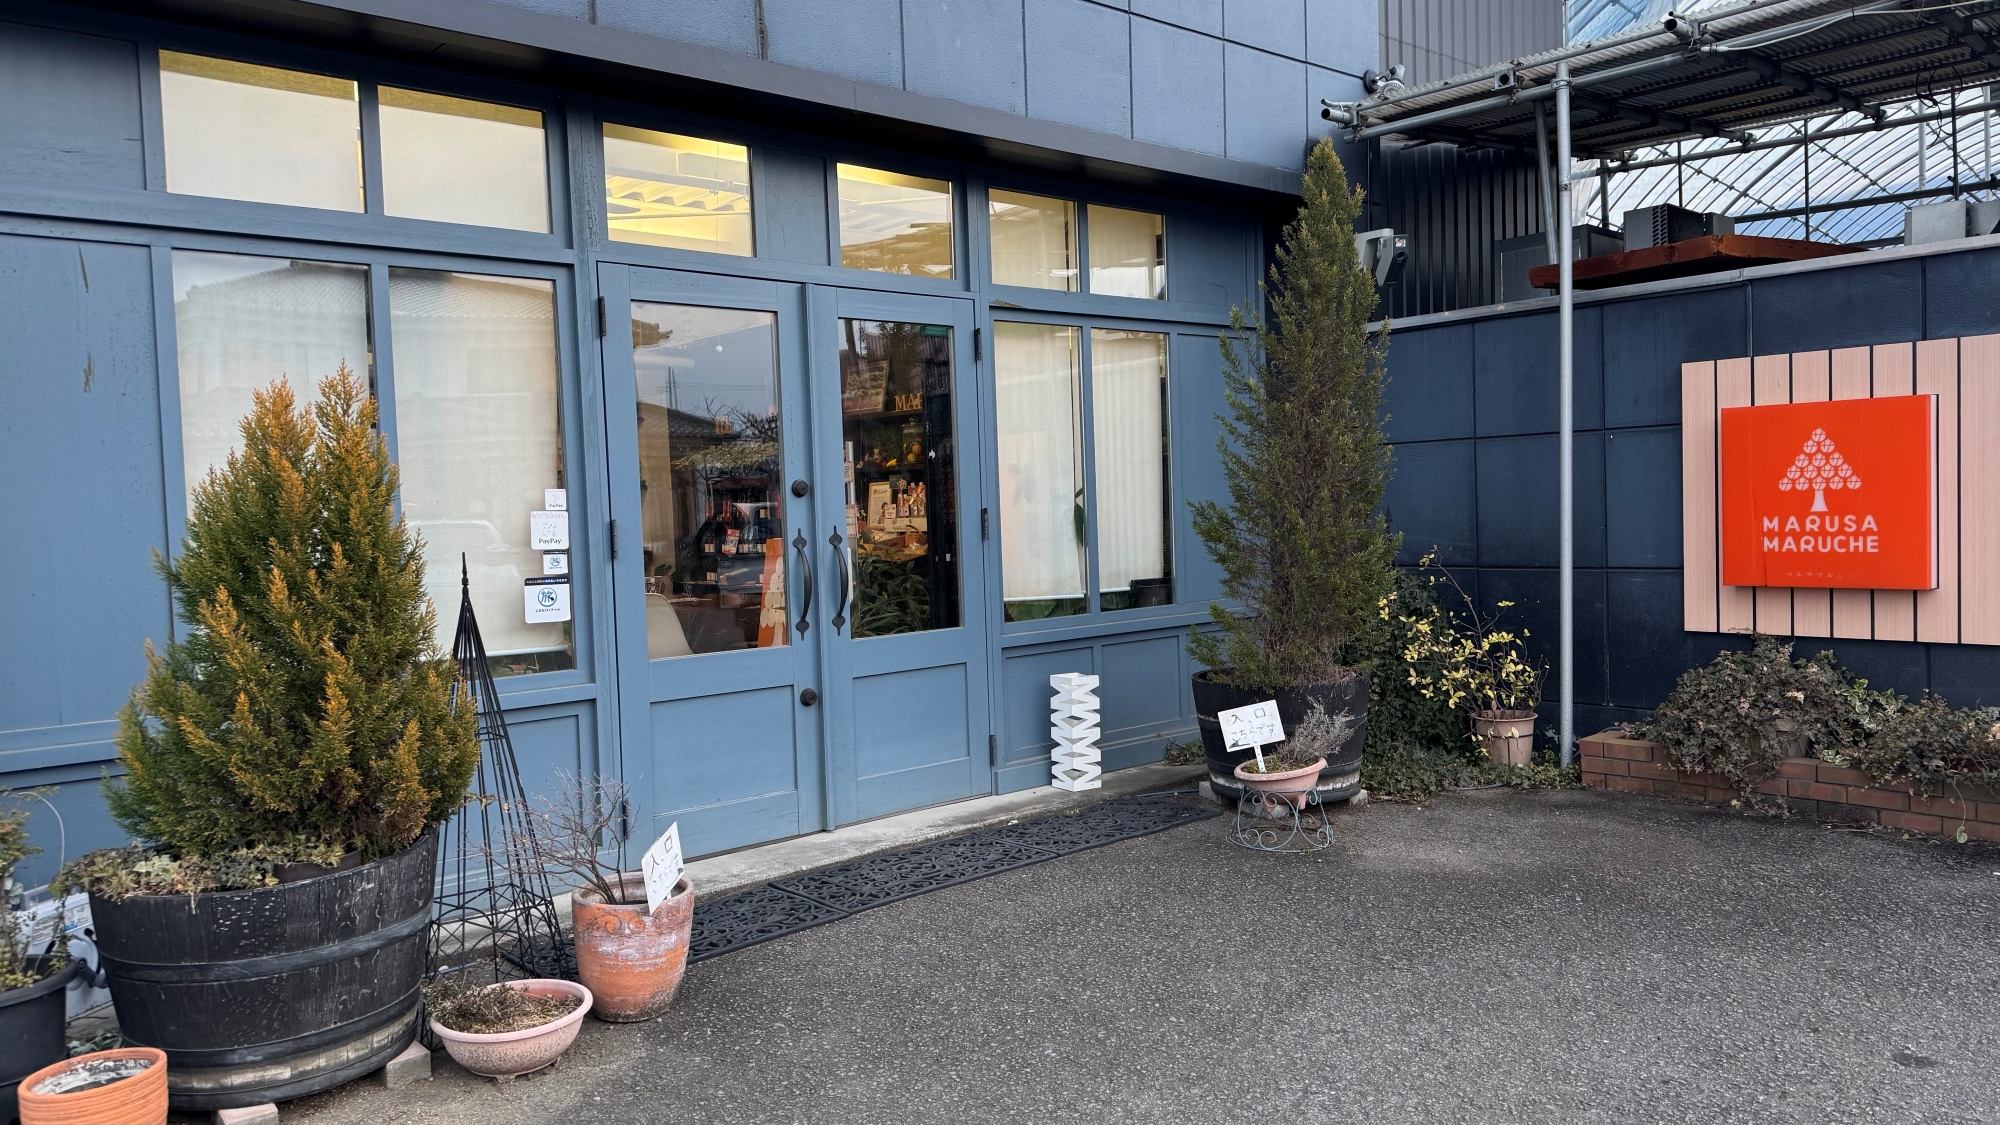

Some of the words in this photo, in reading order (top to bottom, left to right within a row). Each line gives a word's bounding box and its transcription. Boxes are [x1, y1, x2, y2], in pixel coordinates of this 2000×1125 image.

[1763, 514, 1879, 533] MARUSA
[538, 538, 562, 546] PayPay
[1763, 535, 1879, 553] MARUCHE
[540, 590, 555, 603] 旅
